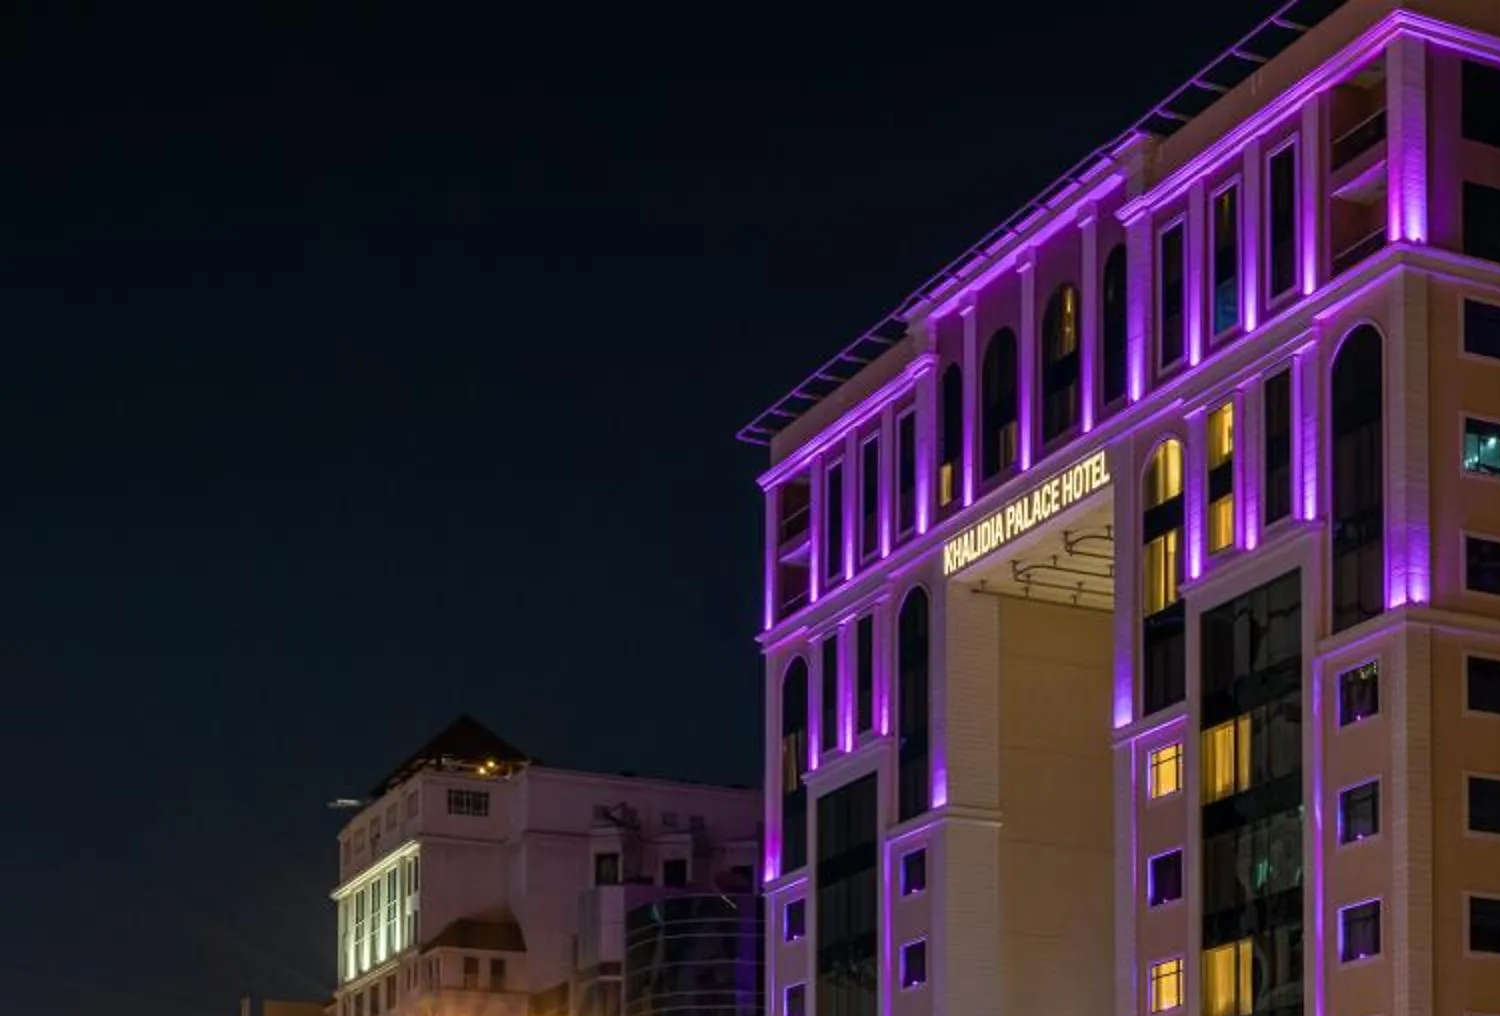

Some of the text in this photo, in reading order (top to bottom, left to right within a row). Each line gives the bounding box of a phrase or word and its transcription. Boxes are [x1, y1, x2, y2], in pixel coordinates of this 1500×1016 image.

[943, 450, 1111, 577] KHALIDIA PALACE HOTEL
